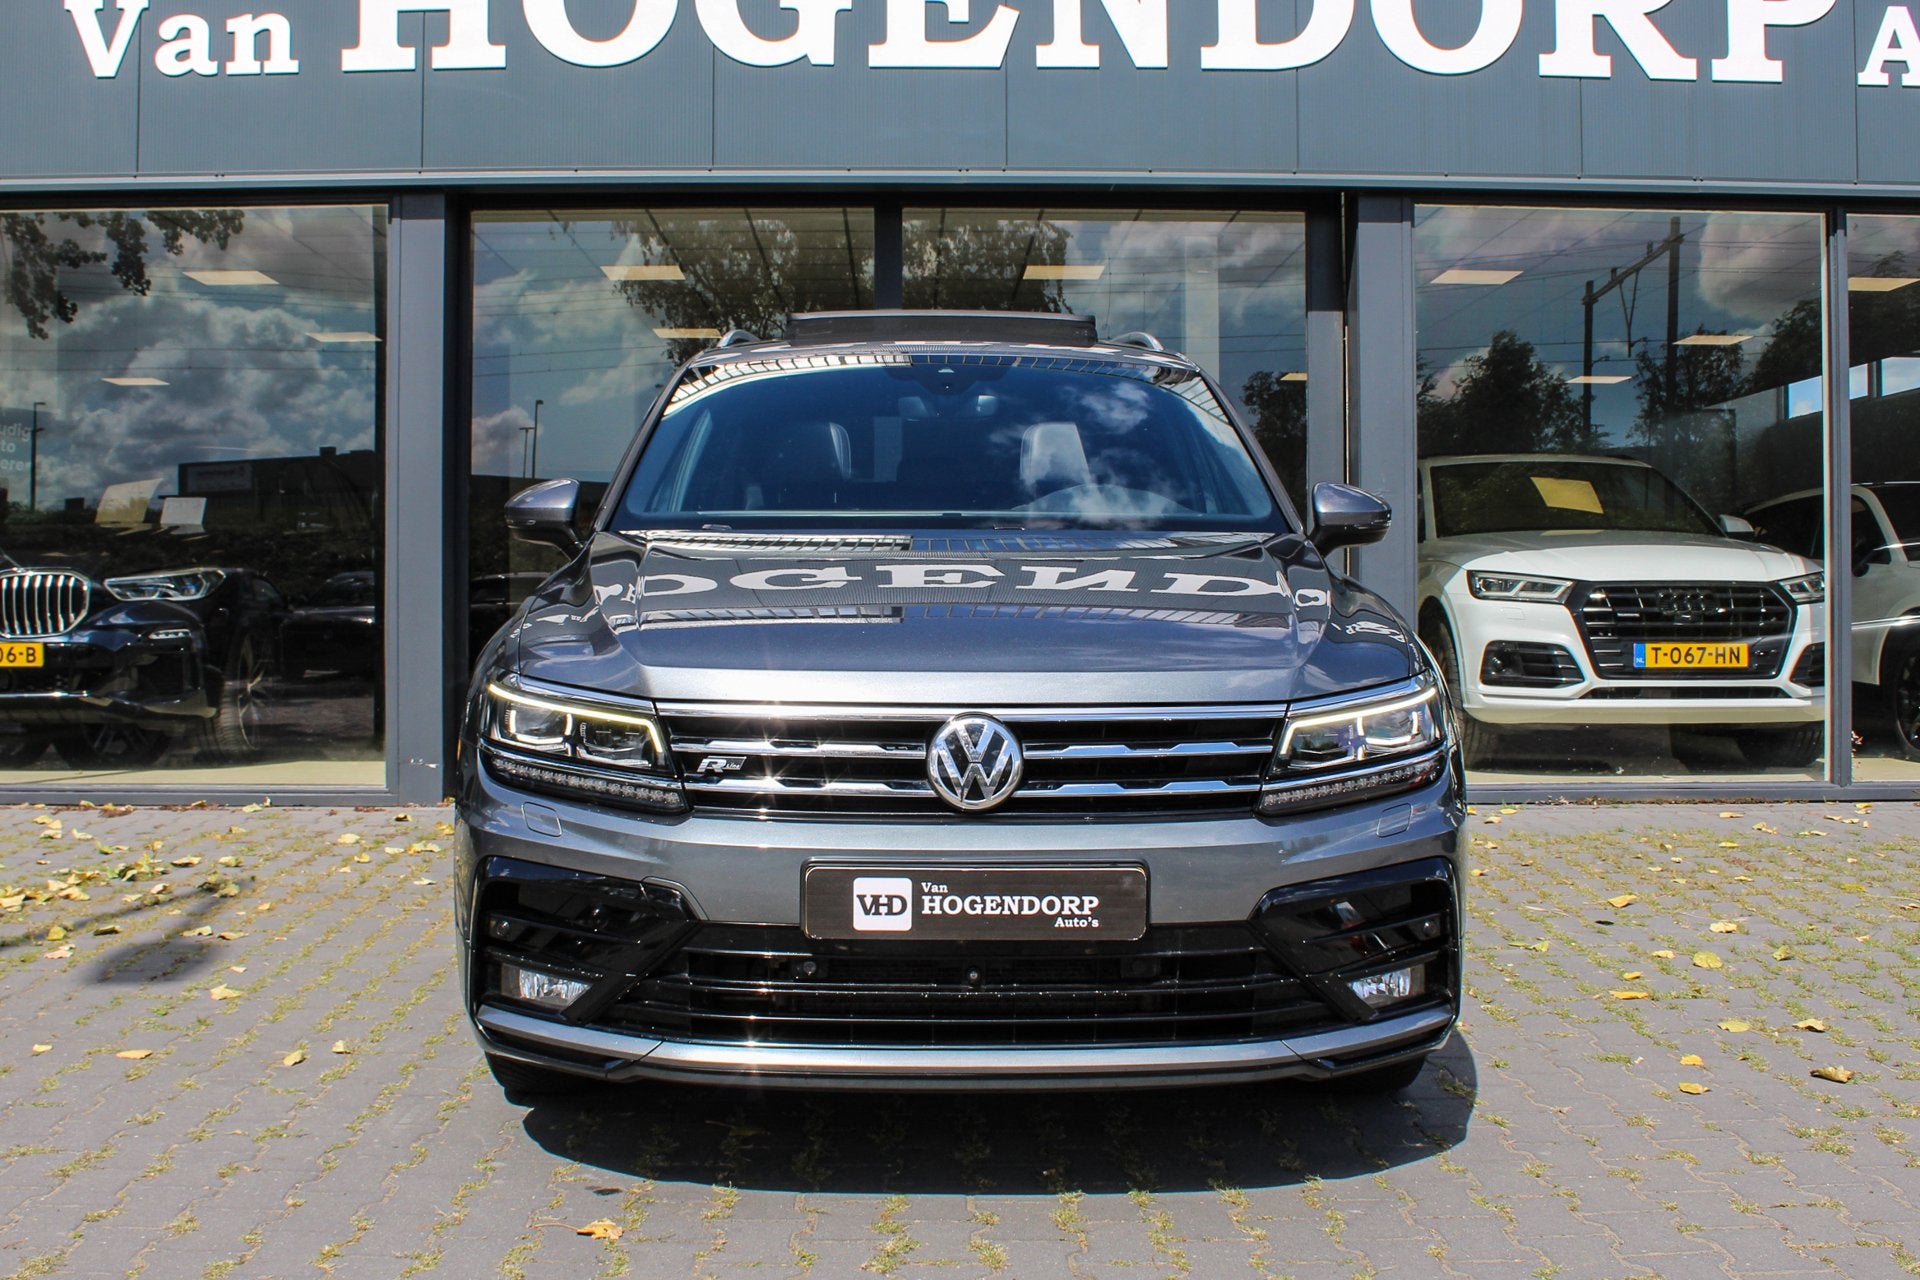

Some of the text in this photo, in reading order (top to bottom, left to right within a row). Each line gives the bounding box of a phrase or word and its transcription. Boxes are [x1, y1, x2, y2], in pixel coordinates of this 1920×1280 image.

[63, 0, 299, 78] Van
[1651, 647, 1740, 664] T-067-HN
[921, 882, 949, 893] Van
[856, 894, 908, 916] VHD
[921, 895, 1100, 915] HOGENDORP
[1054, 916, 1100, 928] Auto's
